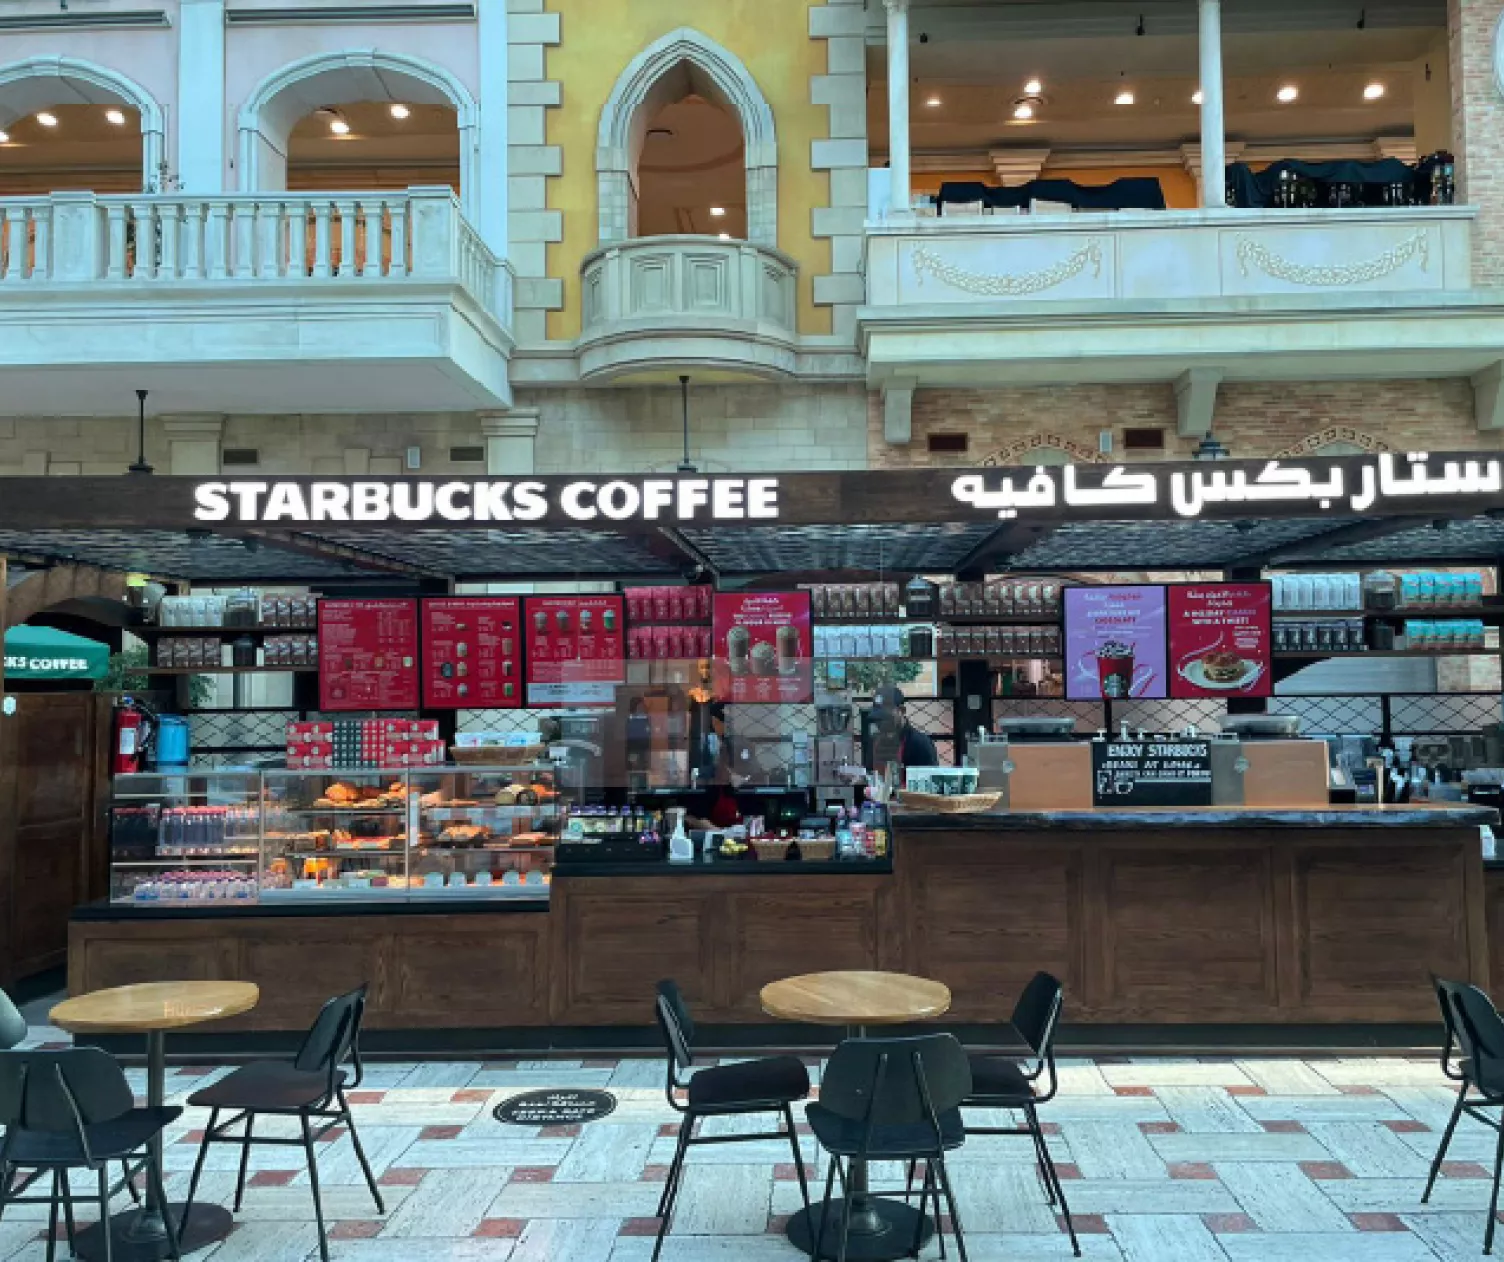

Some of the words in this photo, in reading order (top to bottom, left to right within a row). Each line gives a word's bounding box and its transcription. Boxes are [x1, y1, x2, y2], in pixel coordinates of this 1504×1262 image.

[195, 481, 548, 521] STARBUCKS
[560, 478, 781, 521] COFFEE
[950, 463, 1158, 520] كافيه
[29, 658, 89, 670] COFFEE
